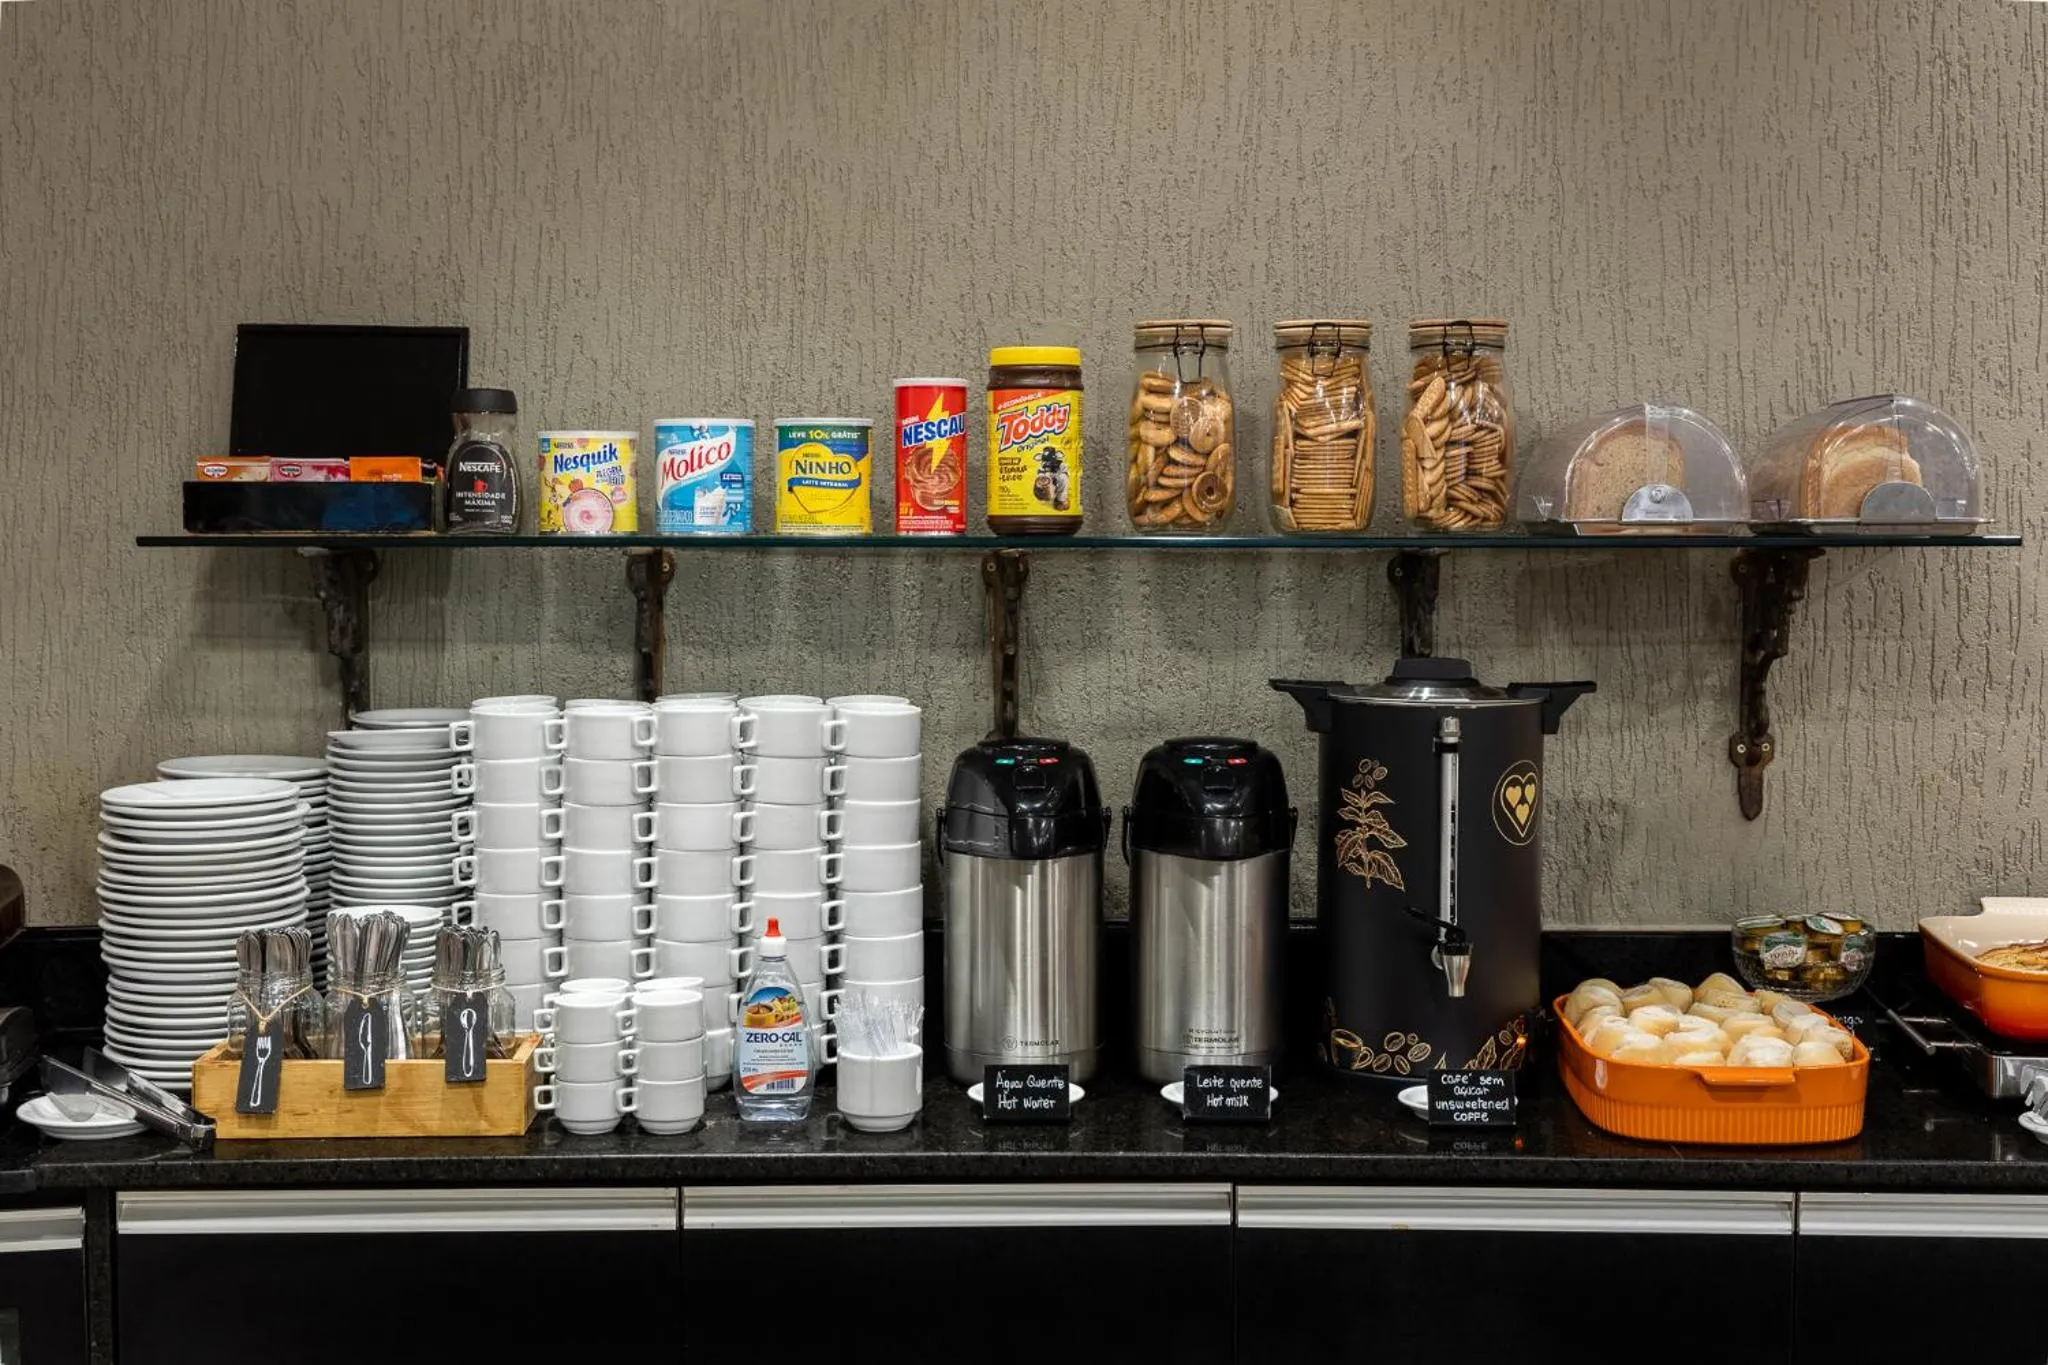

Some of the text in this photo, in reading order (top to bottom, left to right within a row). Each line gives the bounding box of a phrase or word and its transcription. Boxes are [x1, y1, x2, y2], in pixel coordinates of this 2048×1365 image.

[903, 414, 965, 447] NESCAU
[997, 403, 1070, 452] Toddy
[553, 442, 618, 474] Nesquik
[660, 441, 731, 490] Molico
[795, 459, 852, 475] NINHO
[746, 1032, 803, 1044] ZERO-CAL
[1026, 1074, 1065, 1090] Quente
[1196, 1074, 1263, 1093] Leite quente
[1479, 1075, 1504, 1087] sem
[997, 1093, 1018, 1110] Hot
[1206, 1093, 1249, 1108] Hot milk
[1435, 1097, 1510, 1111] unsweetened
